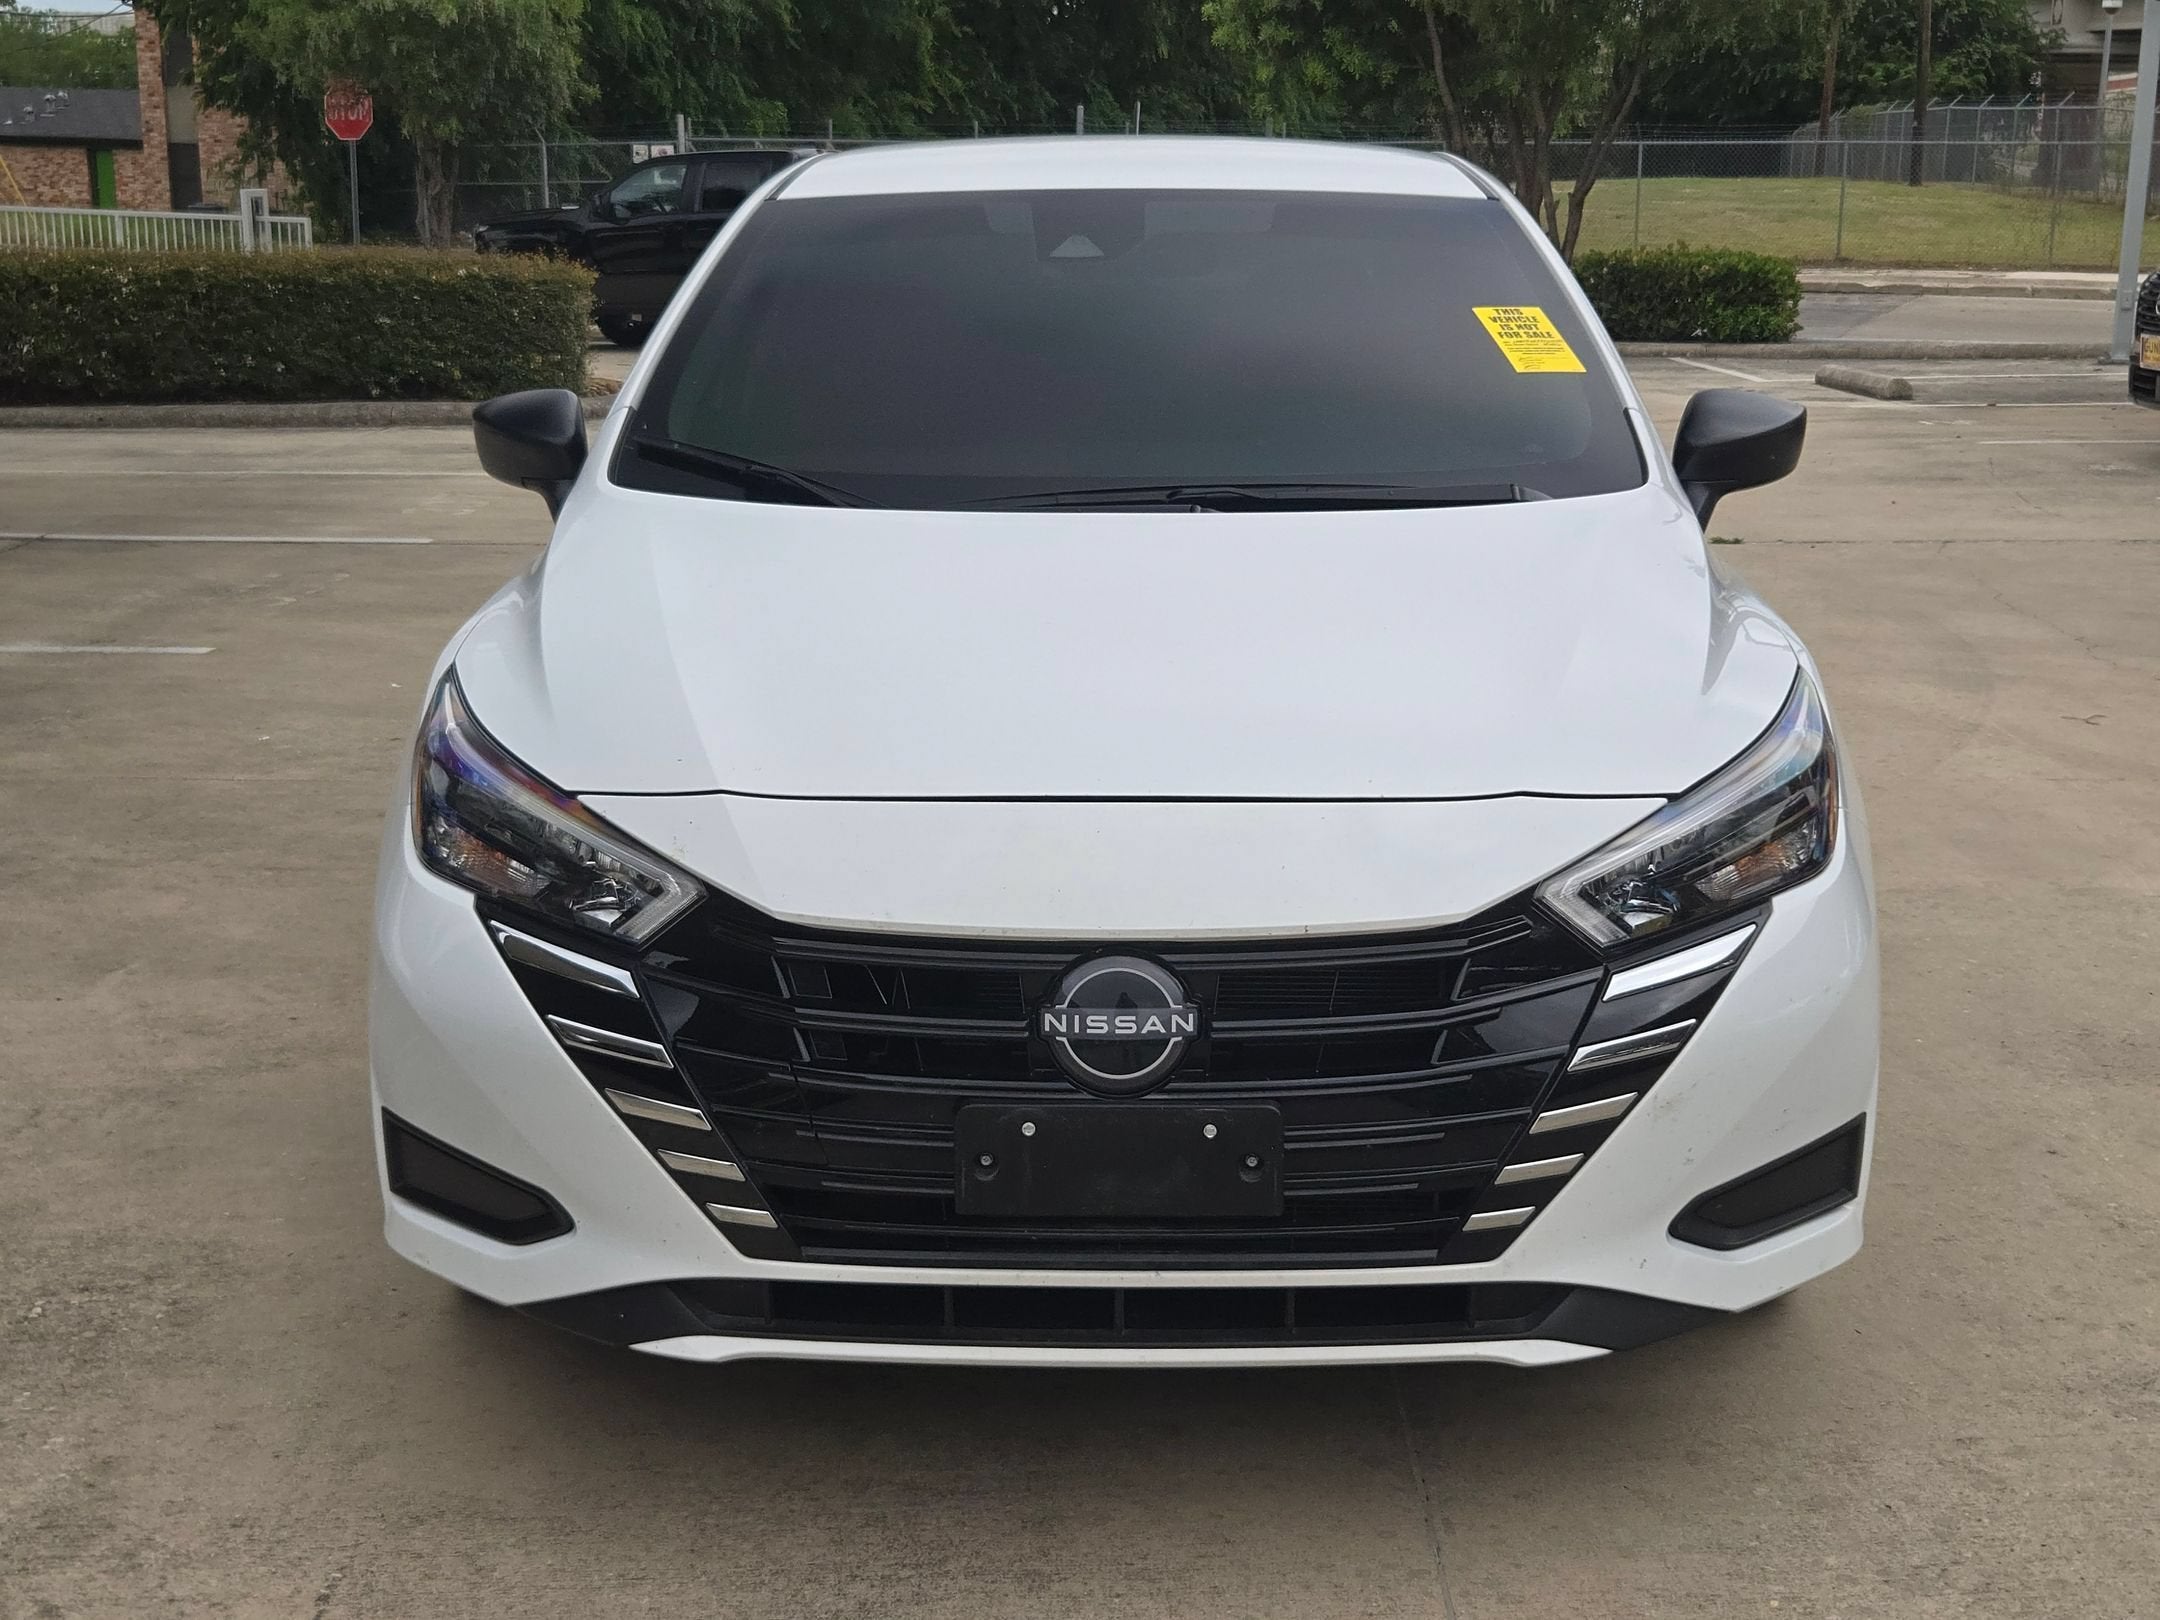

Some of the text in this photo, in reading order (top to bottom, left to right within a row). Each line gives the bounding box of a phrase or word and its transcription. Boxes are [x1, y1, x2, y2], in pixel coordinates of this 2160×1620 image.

[1491, 308, 1524, 316] THIS
[1488, 316, 1541, 324] VEHICLE
[1497, 331, 1555, 339] FOR SALE
[1044, 1013, 1194, 1035] NISSAN
